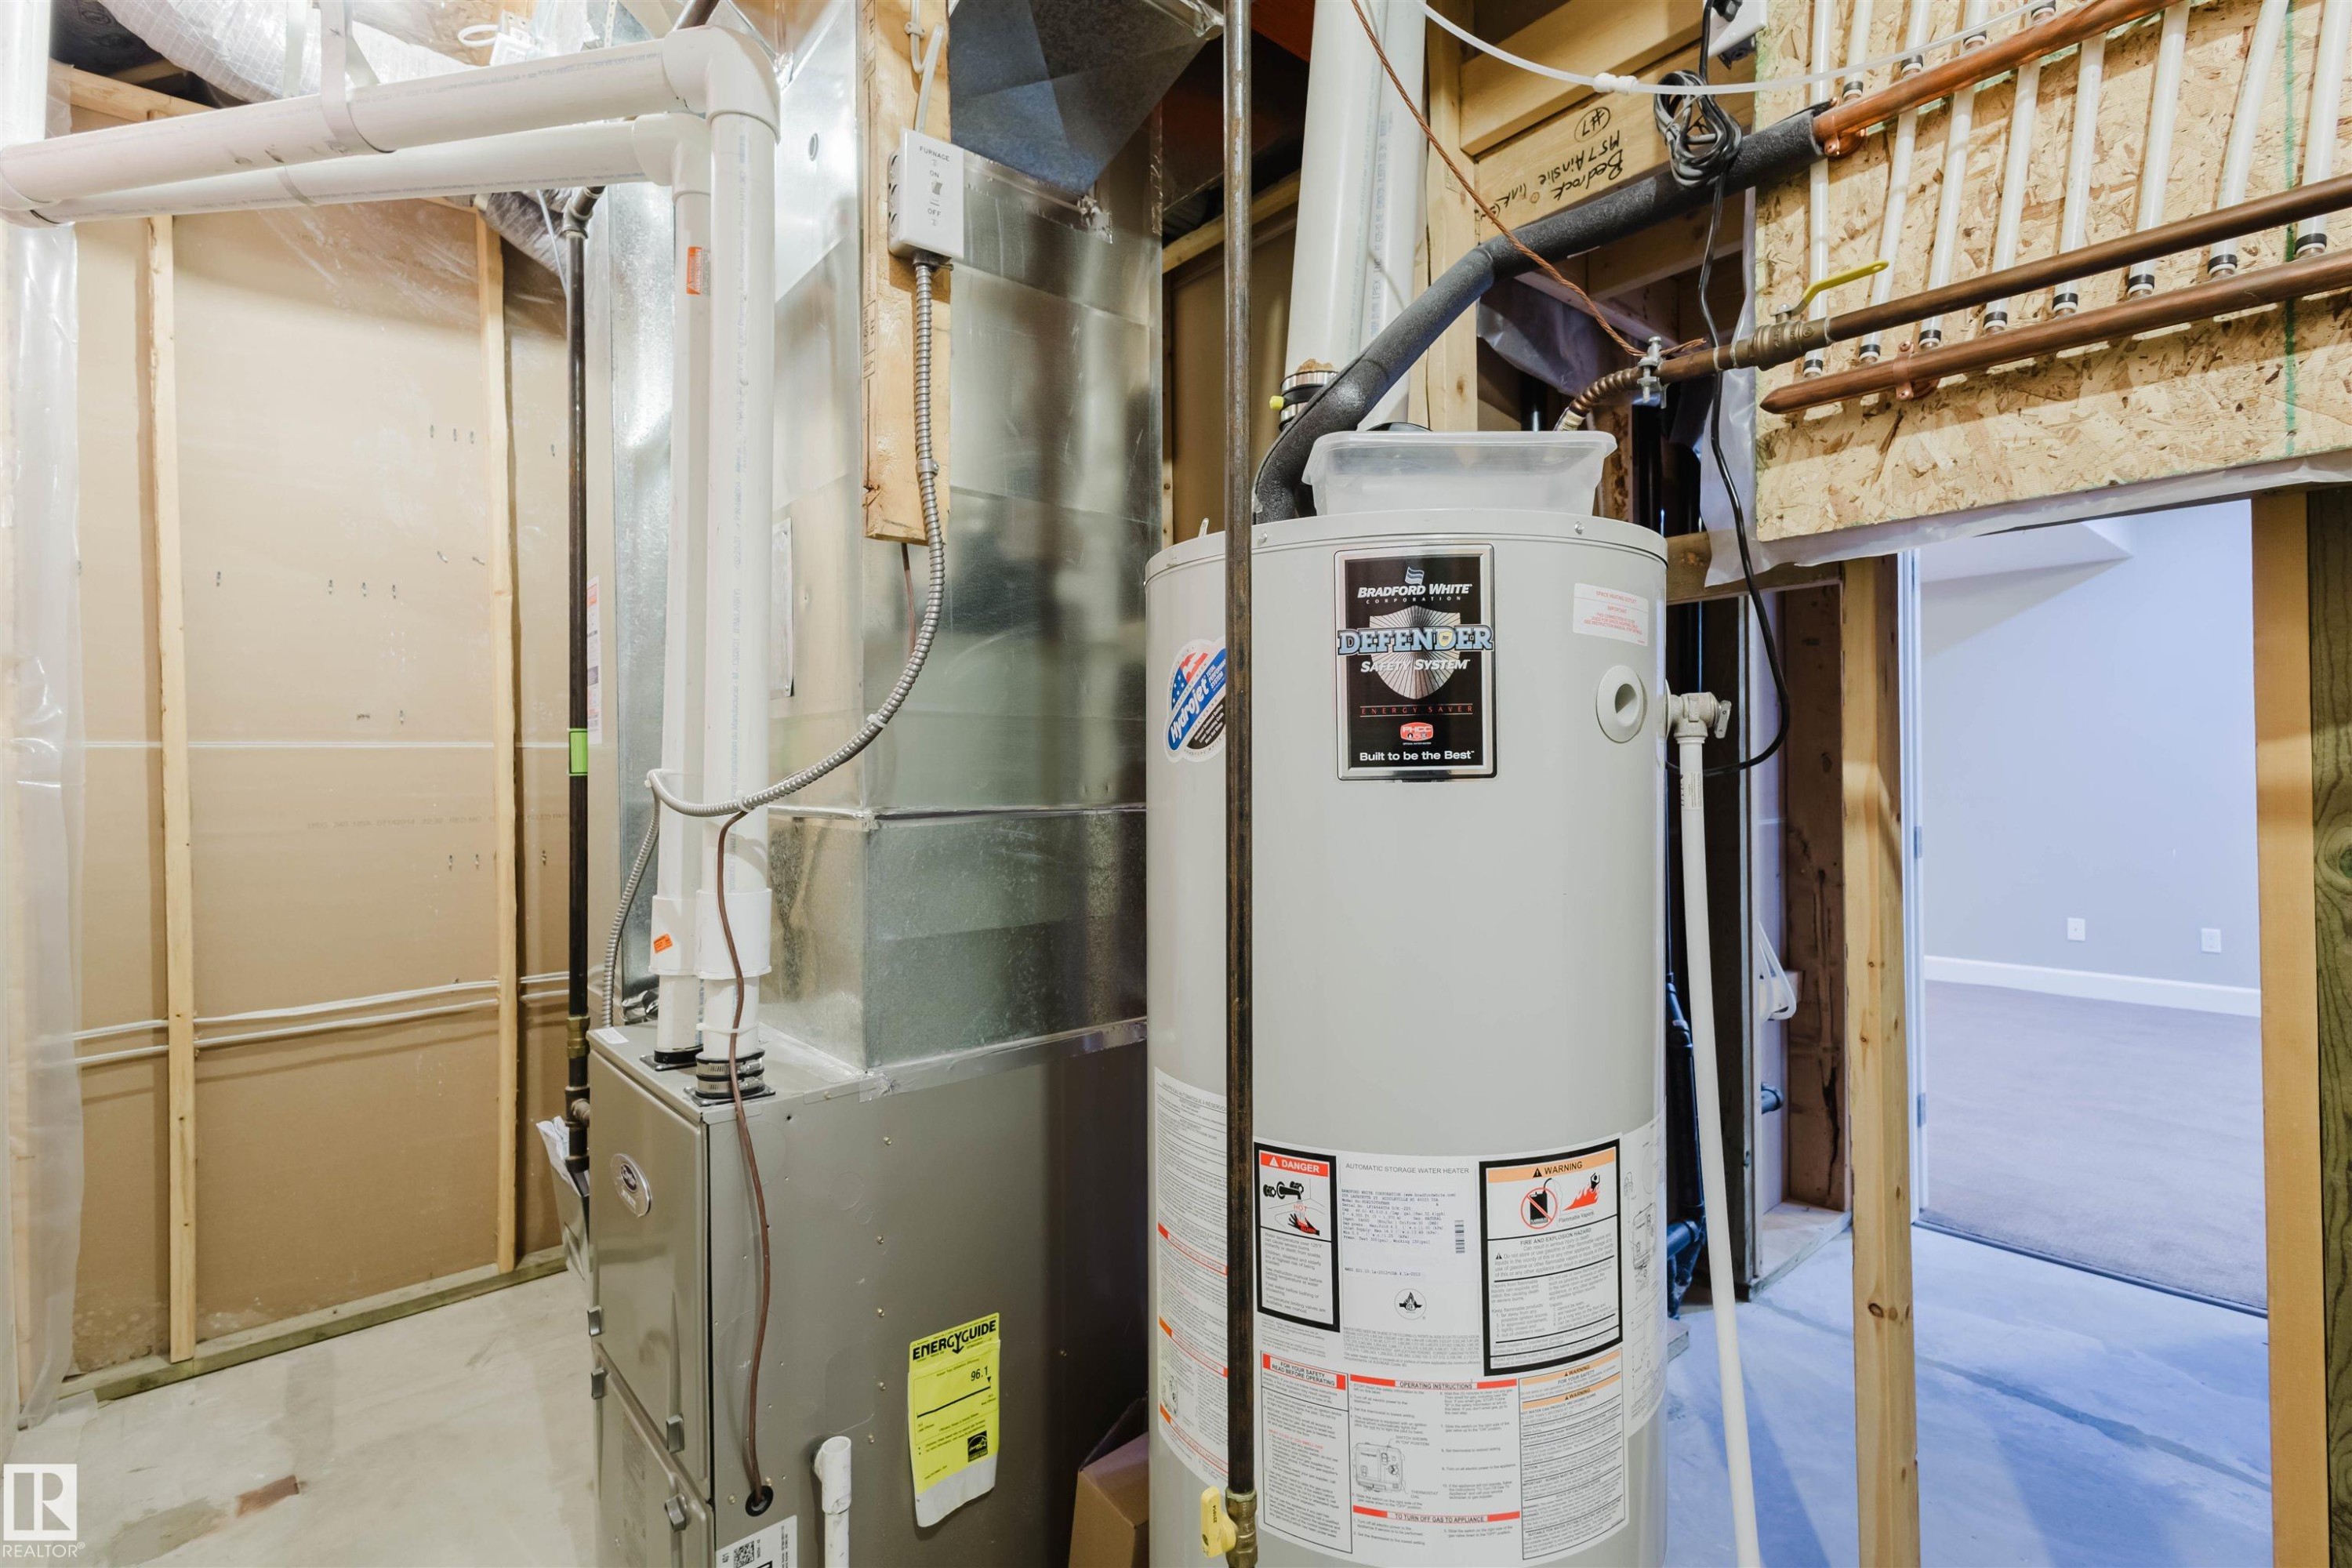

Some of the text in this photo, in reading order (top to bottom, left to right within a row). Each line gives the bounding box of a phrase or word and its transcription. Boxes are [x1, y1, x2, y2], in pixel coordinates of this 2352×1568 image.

[1582, 108, 1605, 136] #7
[1588, 129, 1620, 162] 1957
[920, 146, 949, 162] FURNACE
[1538, 151, 1584, 185] Ainslie
[1550, 149, 1623, 201] Bedrock
[927, 208, 941, 217] OFF
[1357, 586, 1425, 598] BRADFORD
[1338, 626, 1493, 655] DEFENDER
[1360, 661, 1411, 673] SAFETY
[1362, 706, 1417, 715] ENERGY
[1359, 752, 1385, 761] Built
[1403, 752, 1419, 760] be
[1421, 751, 1441, 760] the
[1281, 1159, 1319, 1173] DANGER
[1345, 1163, 1383, 1171] AUTOMATIC
[1544, 1161, 1583, 1175] WARNING
[1559, 1214, 1581, 1223] Flammable
[1301, 1225, 1316, 1233] BURN
[1545, 1232, 1573, 1243] EXPLOSION
[1574, 1227, 1592, 1236] HAZARD
[913, 1319, 996, 1360] ENERGYGUIDE
[971, 1366, 988, 1381] 96.1
[1291, 1364, 1305, 1373] YOUR
[1305, 1369, 1325, 1377] SAFETY
[1569, 1365, 1591, 1375] WARNING
[1580, 1370, 1595, 1379] SAFETY
[1286, 1368, 1305, 1378] BEFORE
[1305, 1374, 1335, 1386] OPERATING
[1569, 1388, 1591, 1399] WARNING
